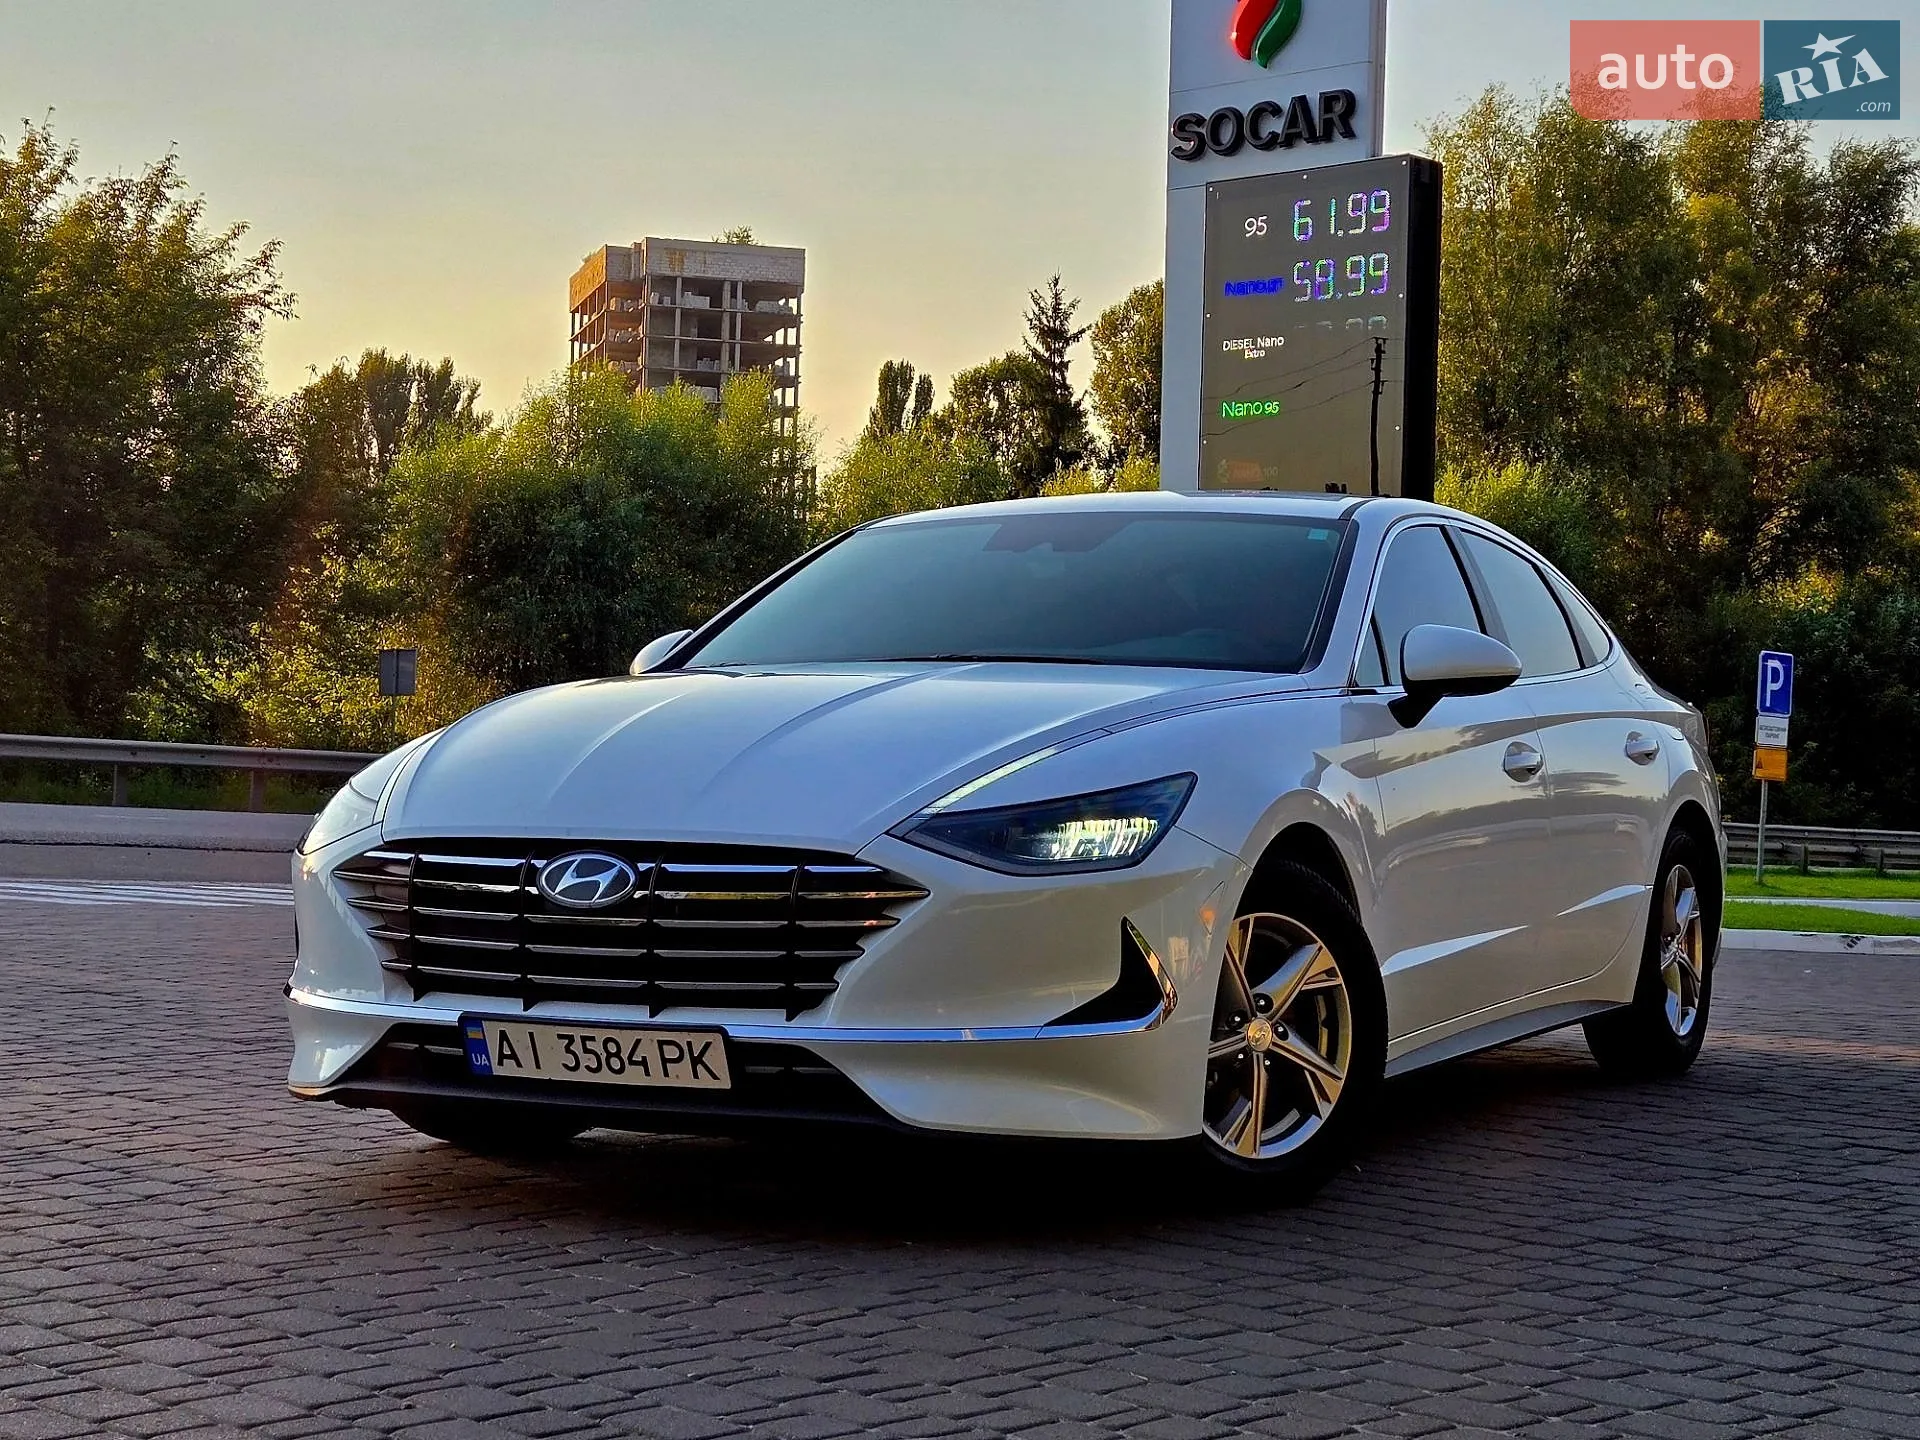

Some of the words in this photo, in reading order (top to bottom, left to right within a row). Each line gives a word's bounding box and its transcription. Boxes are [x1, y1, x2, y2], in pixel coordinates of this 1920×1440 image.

[1170, 88, 1358, 161] SOCAR
[1244, 216, 1269, 238] 95
[1293, 189, 1391, 242] 61.99
[1293, 252, 1389, 302] 58.99
[1222, 338, 1256, 351] DIESEL
[1257, 336, 1285, 348] Nano
[1222, 401, 1263, 418] Nano
[1264, 401, 1280, 414] 95
[1765, 658, 1785, 707] P
[472, 1053, 490, 1067] UA
[497, 1029, 542, 1070] AI
[556, 1033, 652, 1078] 3584
[656, 1038, 721, 1081] PK
